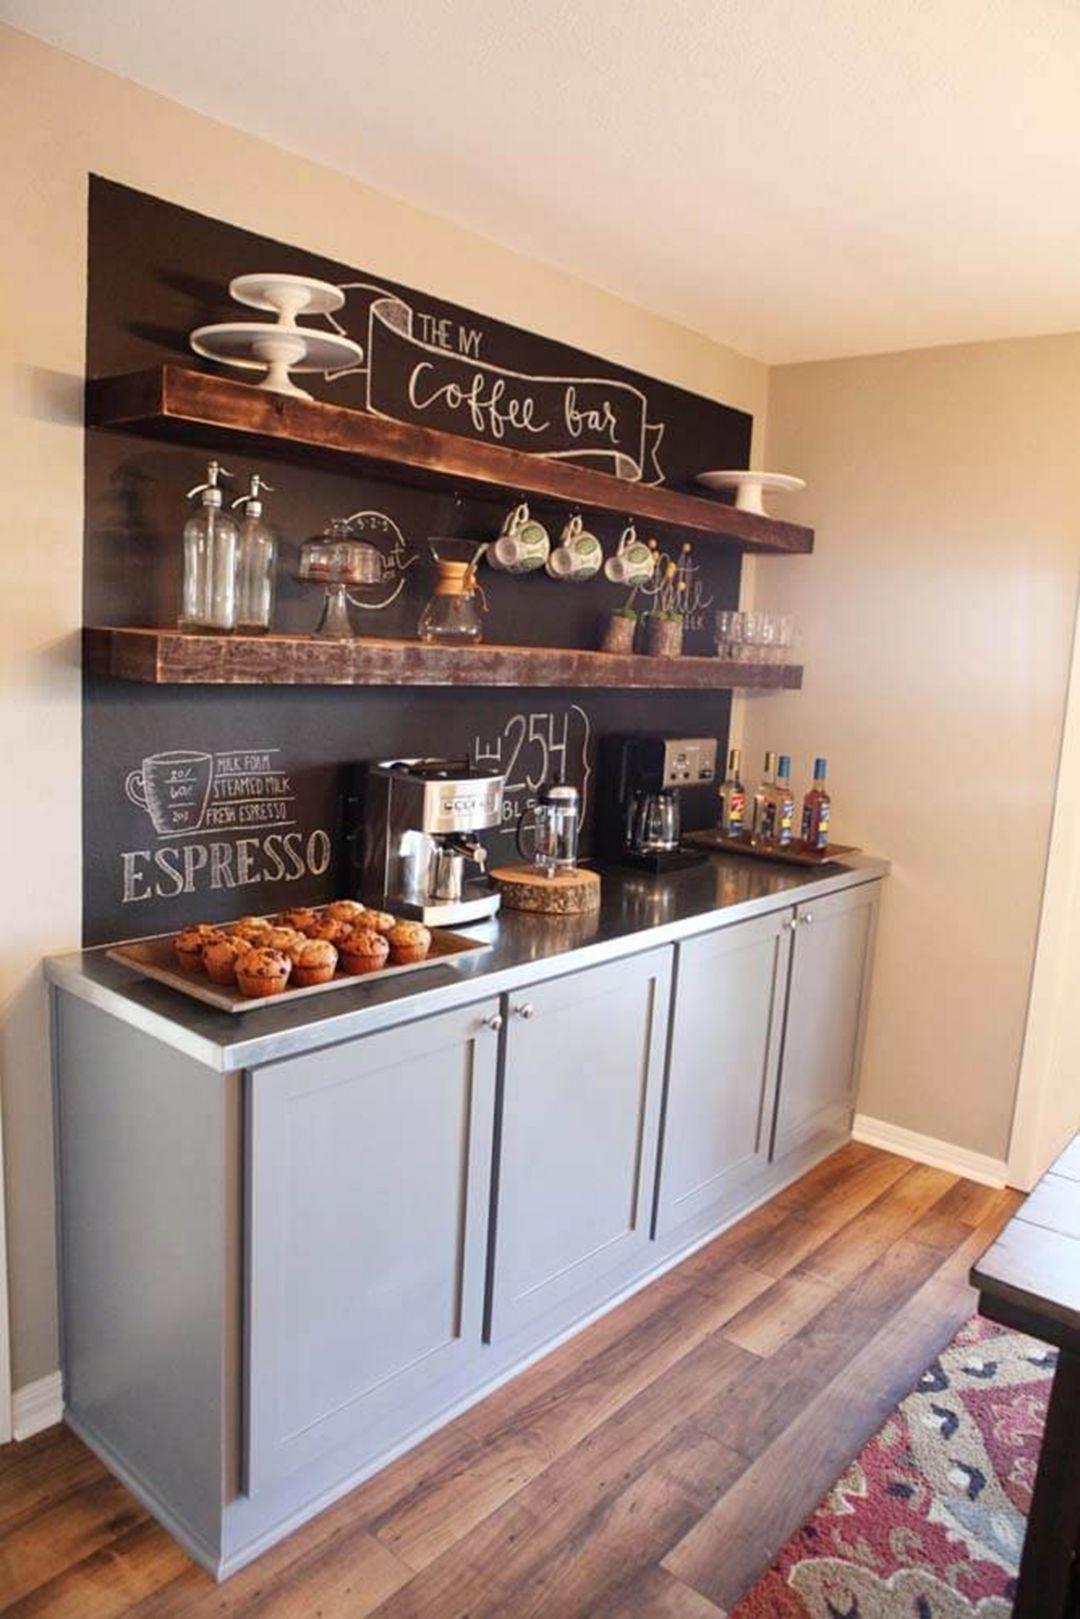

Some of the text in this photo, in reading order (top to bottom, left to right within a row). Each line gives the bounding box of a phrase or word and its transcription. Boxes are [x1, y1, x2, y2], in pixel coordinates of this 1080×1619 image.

[416, 312, 453, 349] THE
[409, 362, 620, 444] Coffee bar
[217, 754, 271, 773] MILK FOAM
[504, 712, 568, 791] 254
[213, 776, 292, 799] STEAMED MILK
[206, 801, 287, 826] FRESH ESPRESSO
[120, 829, 331, 902] ESPRESSO
